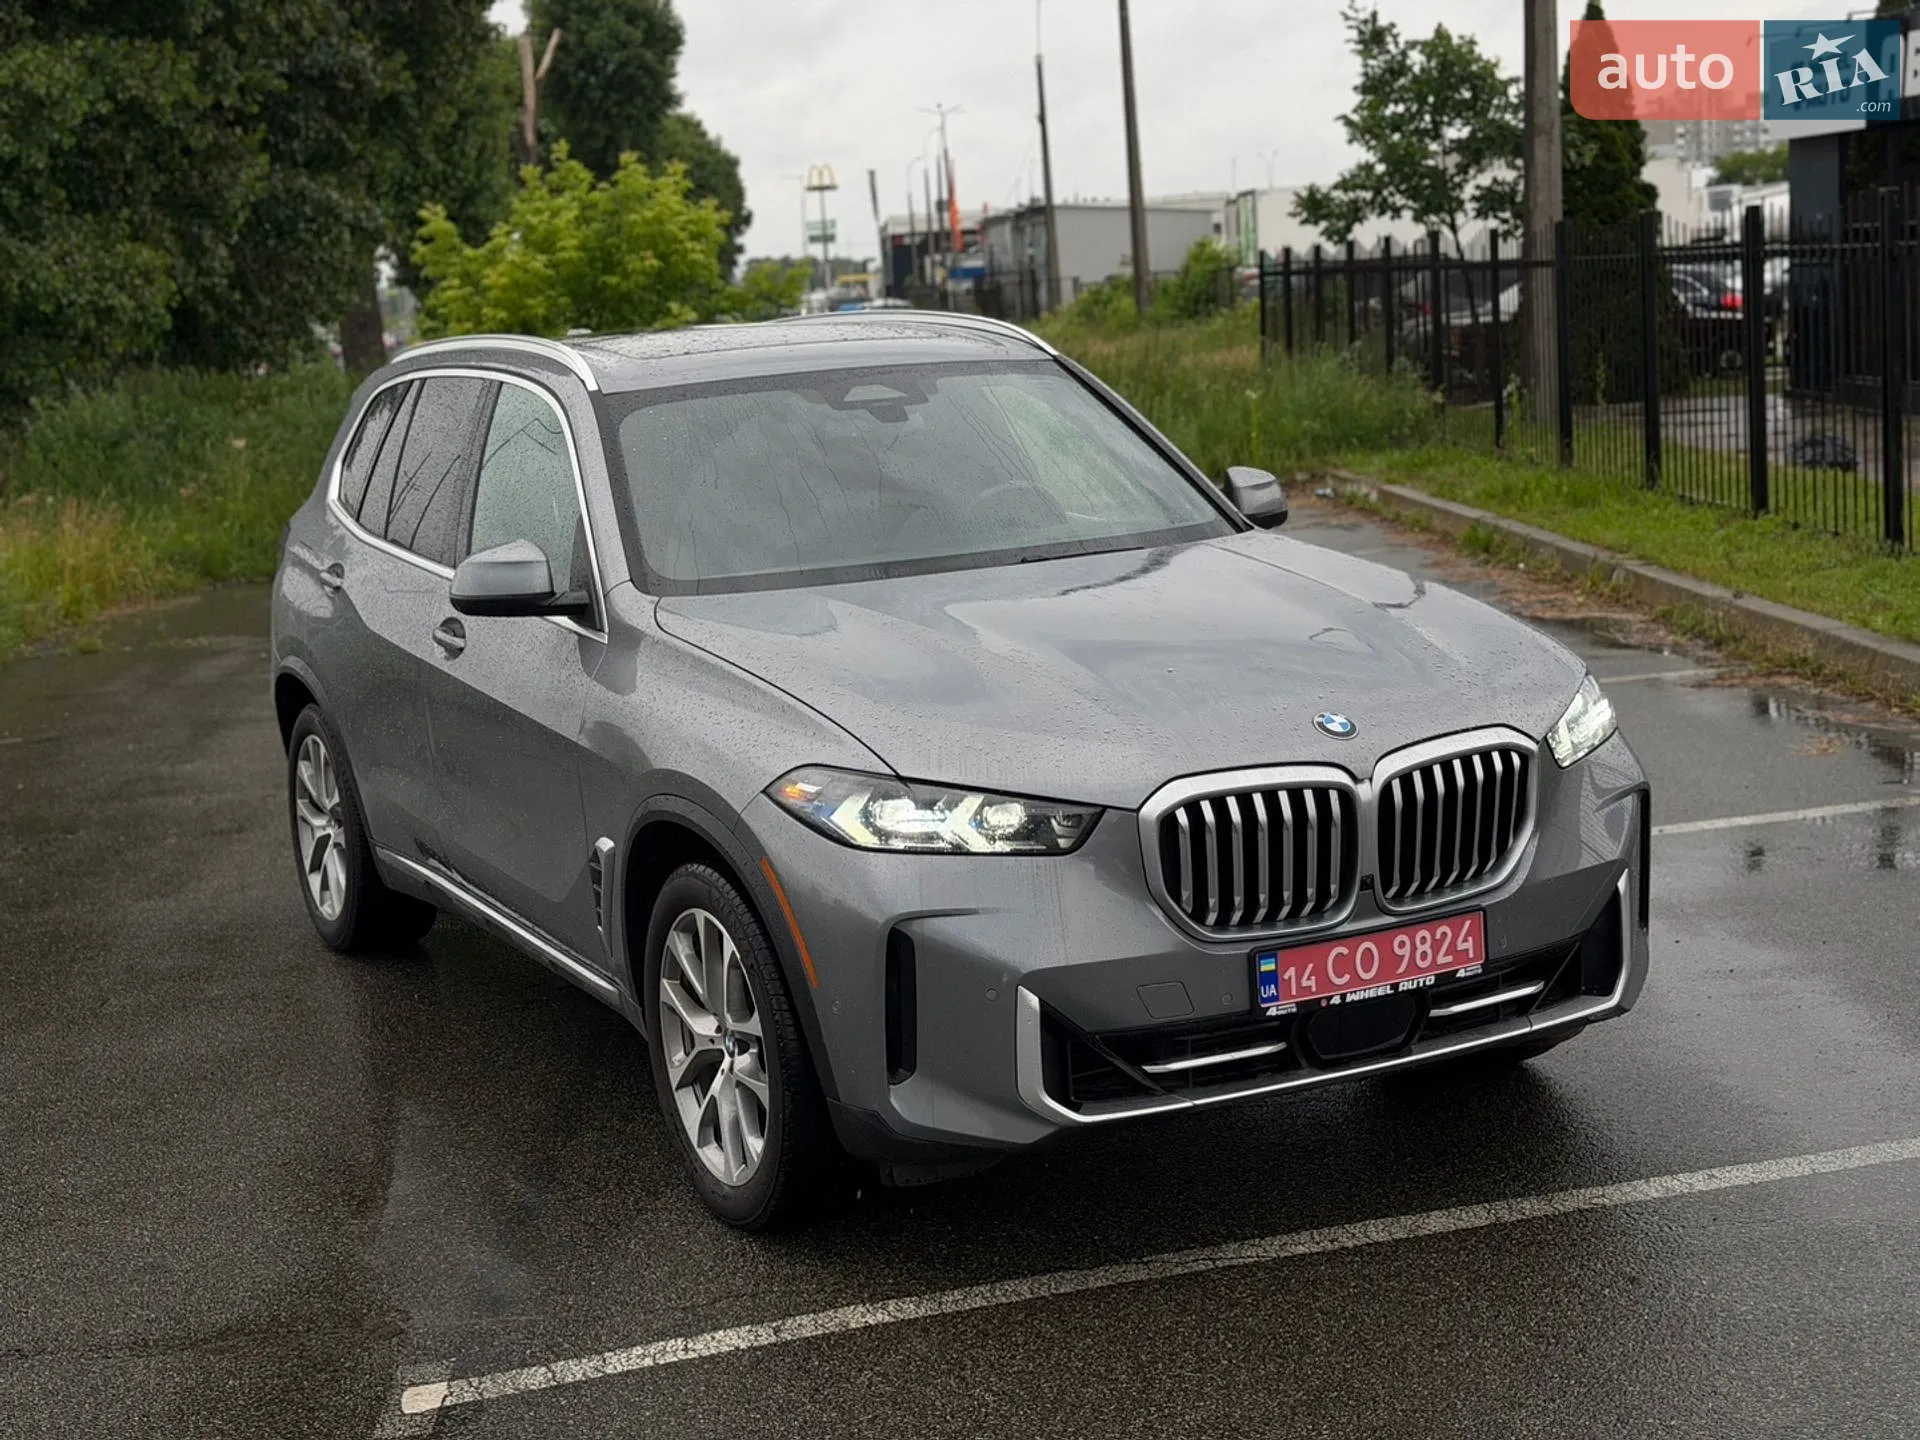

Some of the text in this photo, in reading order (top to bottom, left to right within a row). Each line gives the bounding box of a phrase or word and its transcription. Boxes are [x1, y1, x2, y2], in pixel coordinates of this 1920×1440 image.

[1282, 963, 1317, 996] 14
[1392, 919, 1475, 975] 9824
[1260, 985, 1278, 999] UA
[1345, 984, 1395, 1003] WHEEL
[1398, 974, 1436, 992] AUTO
